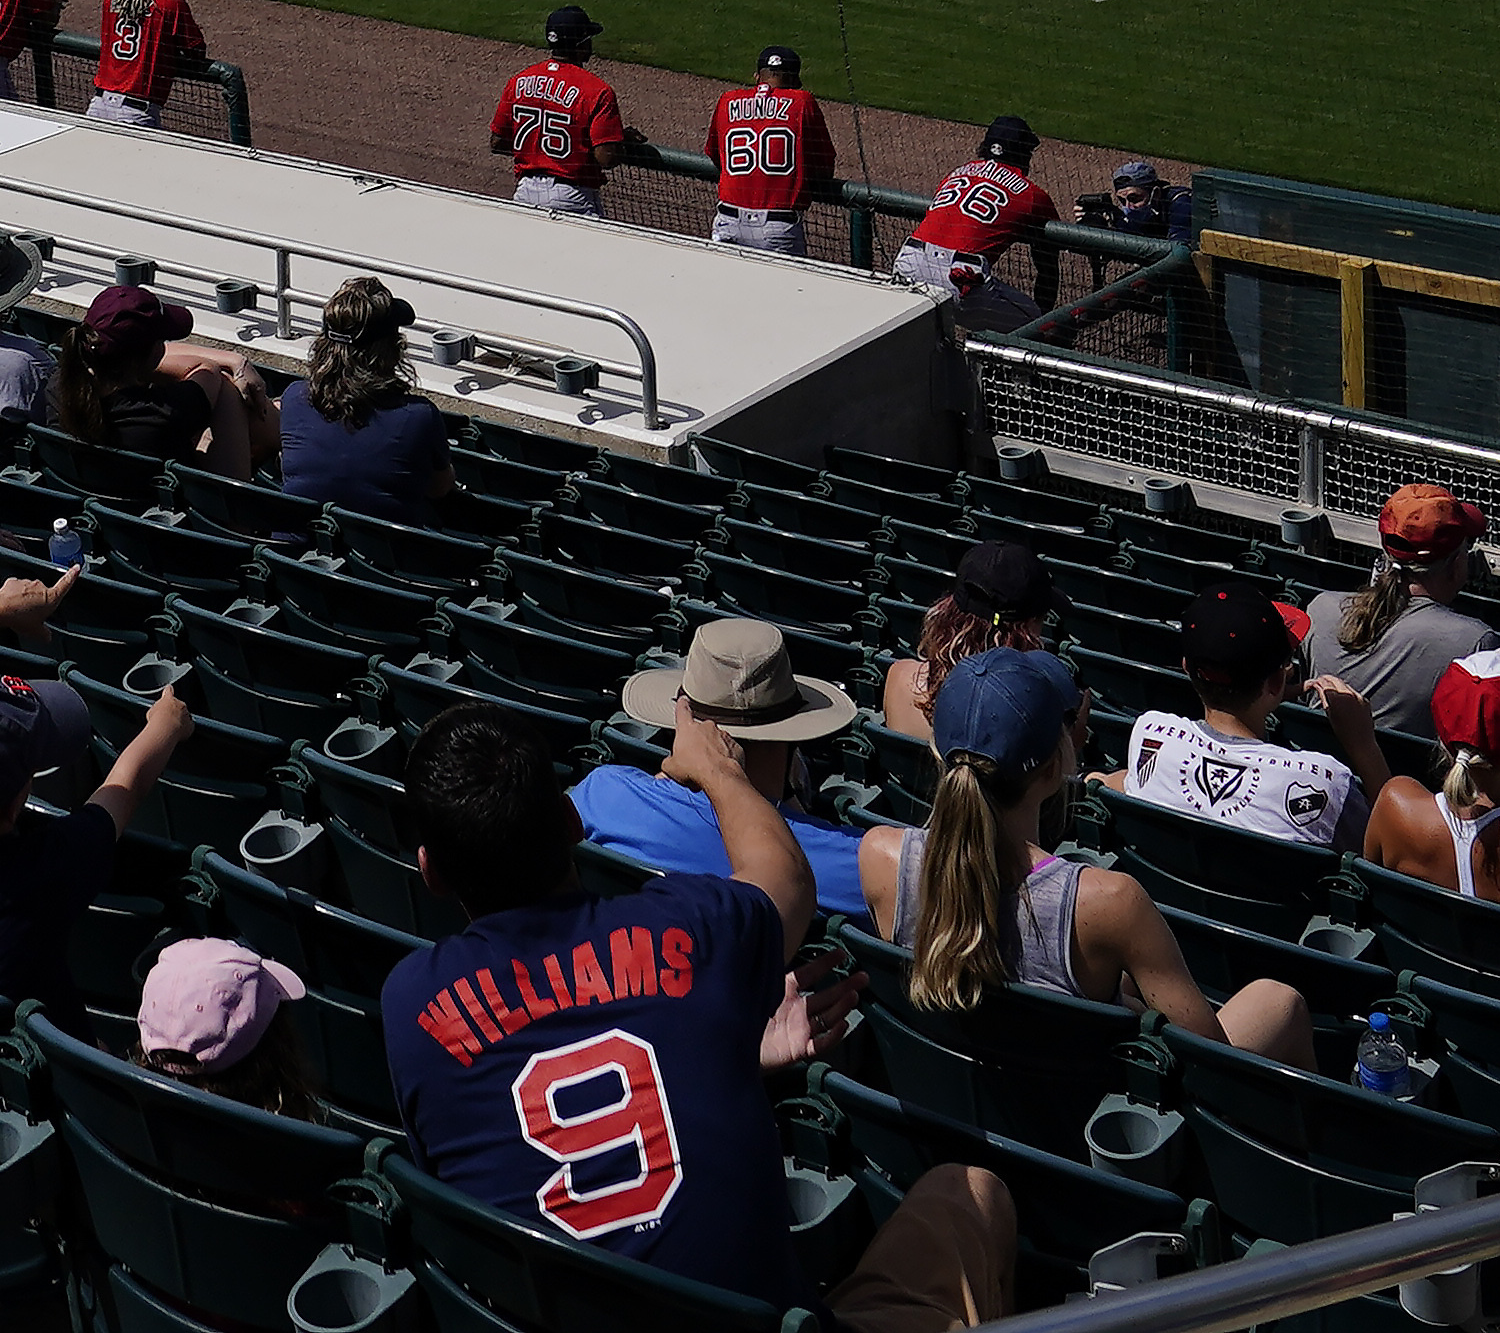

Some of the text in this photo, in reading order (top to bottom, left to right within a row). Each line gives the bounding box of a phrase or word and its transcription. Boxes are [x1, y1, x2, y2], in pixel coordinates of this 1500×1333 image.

[111, 17, 142, 61] 3
[516, 75, 579, 108] PUELLO
[513, 104, 571, 159] 75
[725, 127, 797, 176] 60
[1144, 722, 1334, 782] AMERICAN GHTER
[1219, 766, 1262, 819] ATHLETICS
[416, 925, 695, 1069] WILLIAMS
[510, 1027, 683, 1242] 9
